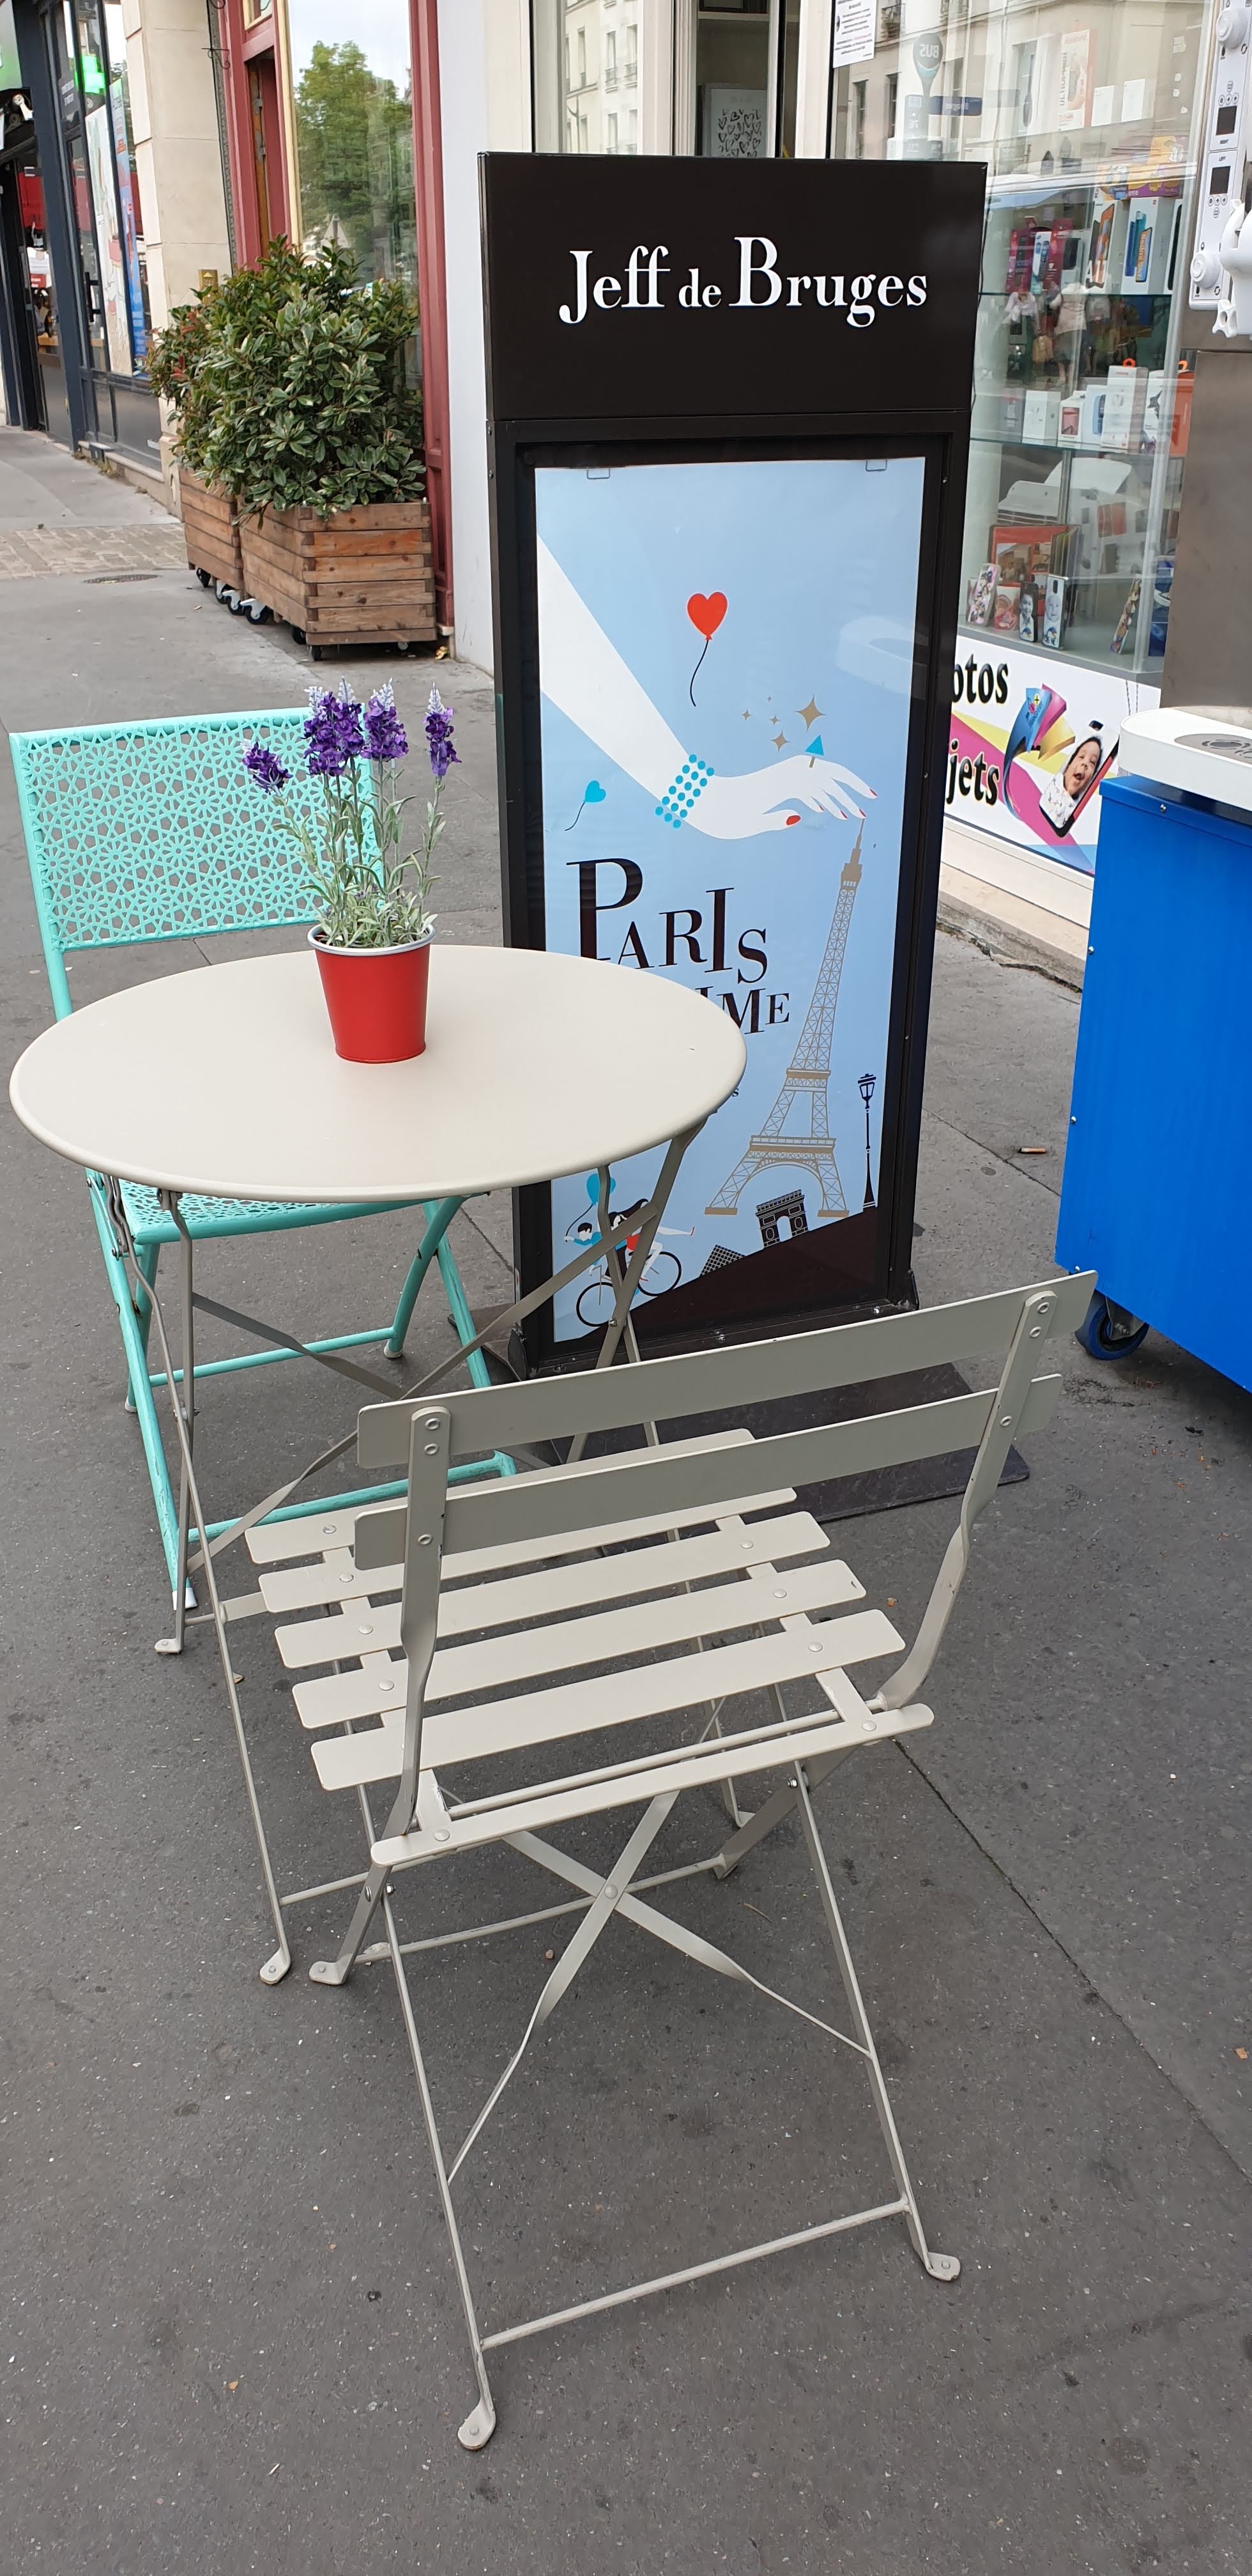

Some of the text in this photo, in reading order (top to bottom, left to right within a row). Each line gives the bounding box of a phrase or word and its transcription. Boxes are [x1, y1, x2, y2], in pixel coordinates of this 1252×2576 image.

[559, 236, 928, 328] Jeff de Bruges
[566, 857, 768, 984] PARIS
